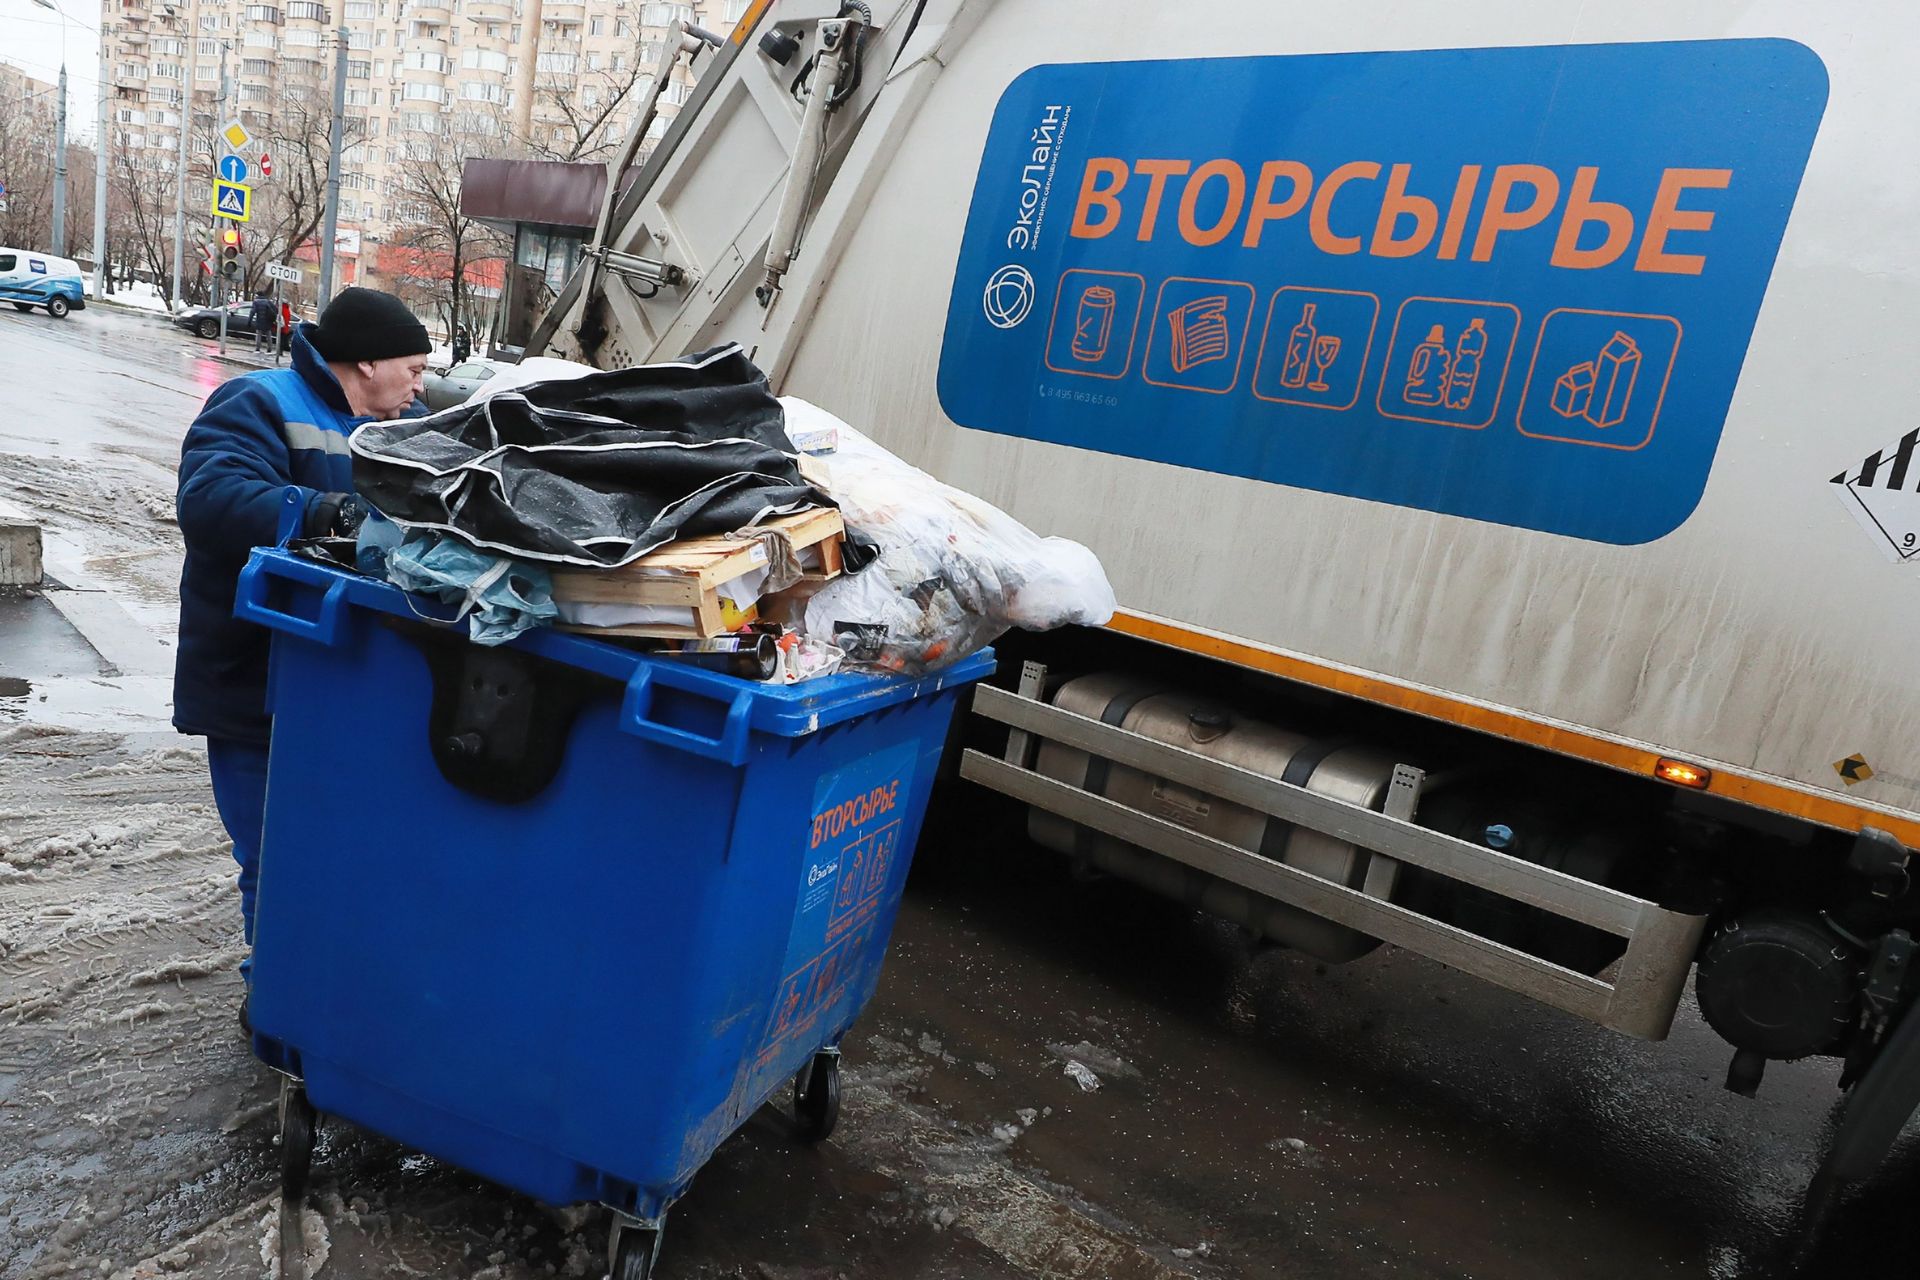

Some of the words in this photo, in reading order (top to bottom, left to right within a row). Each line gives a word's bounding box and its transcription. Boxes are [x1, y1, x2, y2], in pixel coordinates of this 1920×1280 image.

[1007, 105, 1062, 250] ЭкоЛайн
[1069, 156, 1733, 276] ВТОРСЫРЬЕ
[270, 265, 298, 281] СТОП
[1903, 533, 1916, 547] 9
[810, 779, 900, 849] ВТОРСЫРЬЕ
